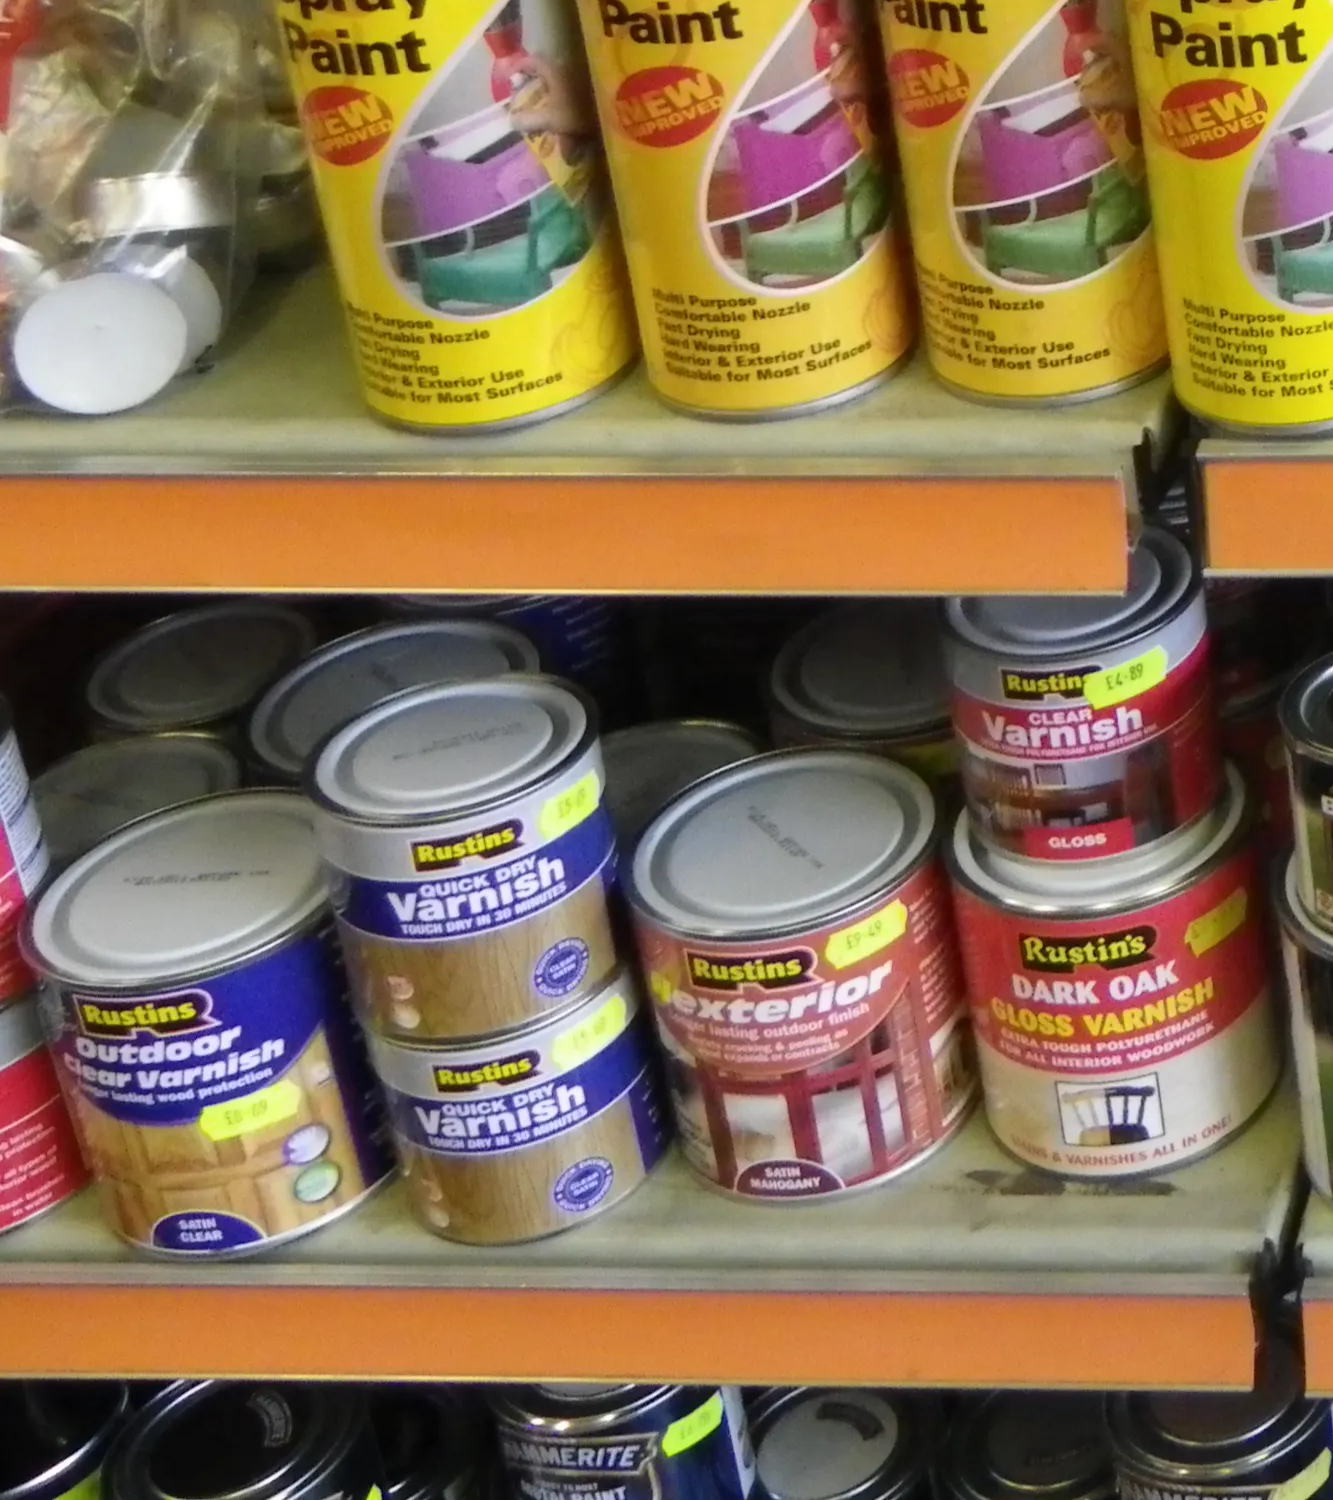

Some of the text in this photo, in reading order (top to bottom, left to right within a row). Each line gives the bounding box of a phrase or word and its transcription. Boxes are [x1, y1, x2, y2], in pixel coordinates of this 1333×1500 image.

[1150, 11, 1308, 69] Paint
[982, 707, 1142, 749] Varnish
[1028, 709, 1093, 725] CLEAR
[416, 828, 516, 863] Rustins
[1048, 833, 1107, 848] GLOSS
[386, 857, 565, 923] Varnish
[420, 855, 537, 898] QUICK DRY
[401, 918, 443, 935] TOUCH
[1023, 934, 1146, 965] Rustin's
[693, 958, 802, 981] Rustins
[1012, 959, 1179, 1005] DARK OAK
[670, 960, 892, 1023] exterior
[1083, 977, 1214, 1036] VARNISH
[83, 1002, 196, 1026] Rustins
[763, 1003, 870, 1038] outdoor finish
[74, 1025, 242, 1063] Outdoor
[137, 1038, 284, 1089] Varnish
[438, 1057, 532, 1086] Rustins
[414, 1083, 586, 1138] Varnish
[442, 1082, 555, 1117] QUICK DRY
